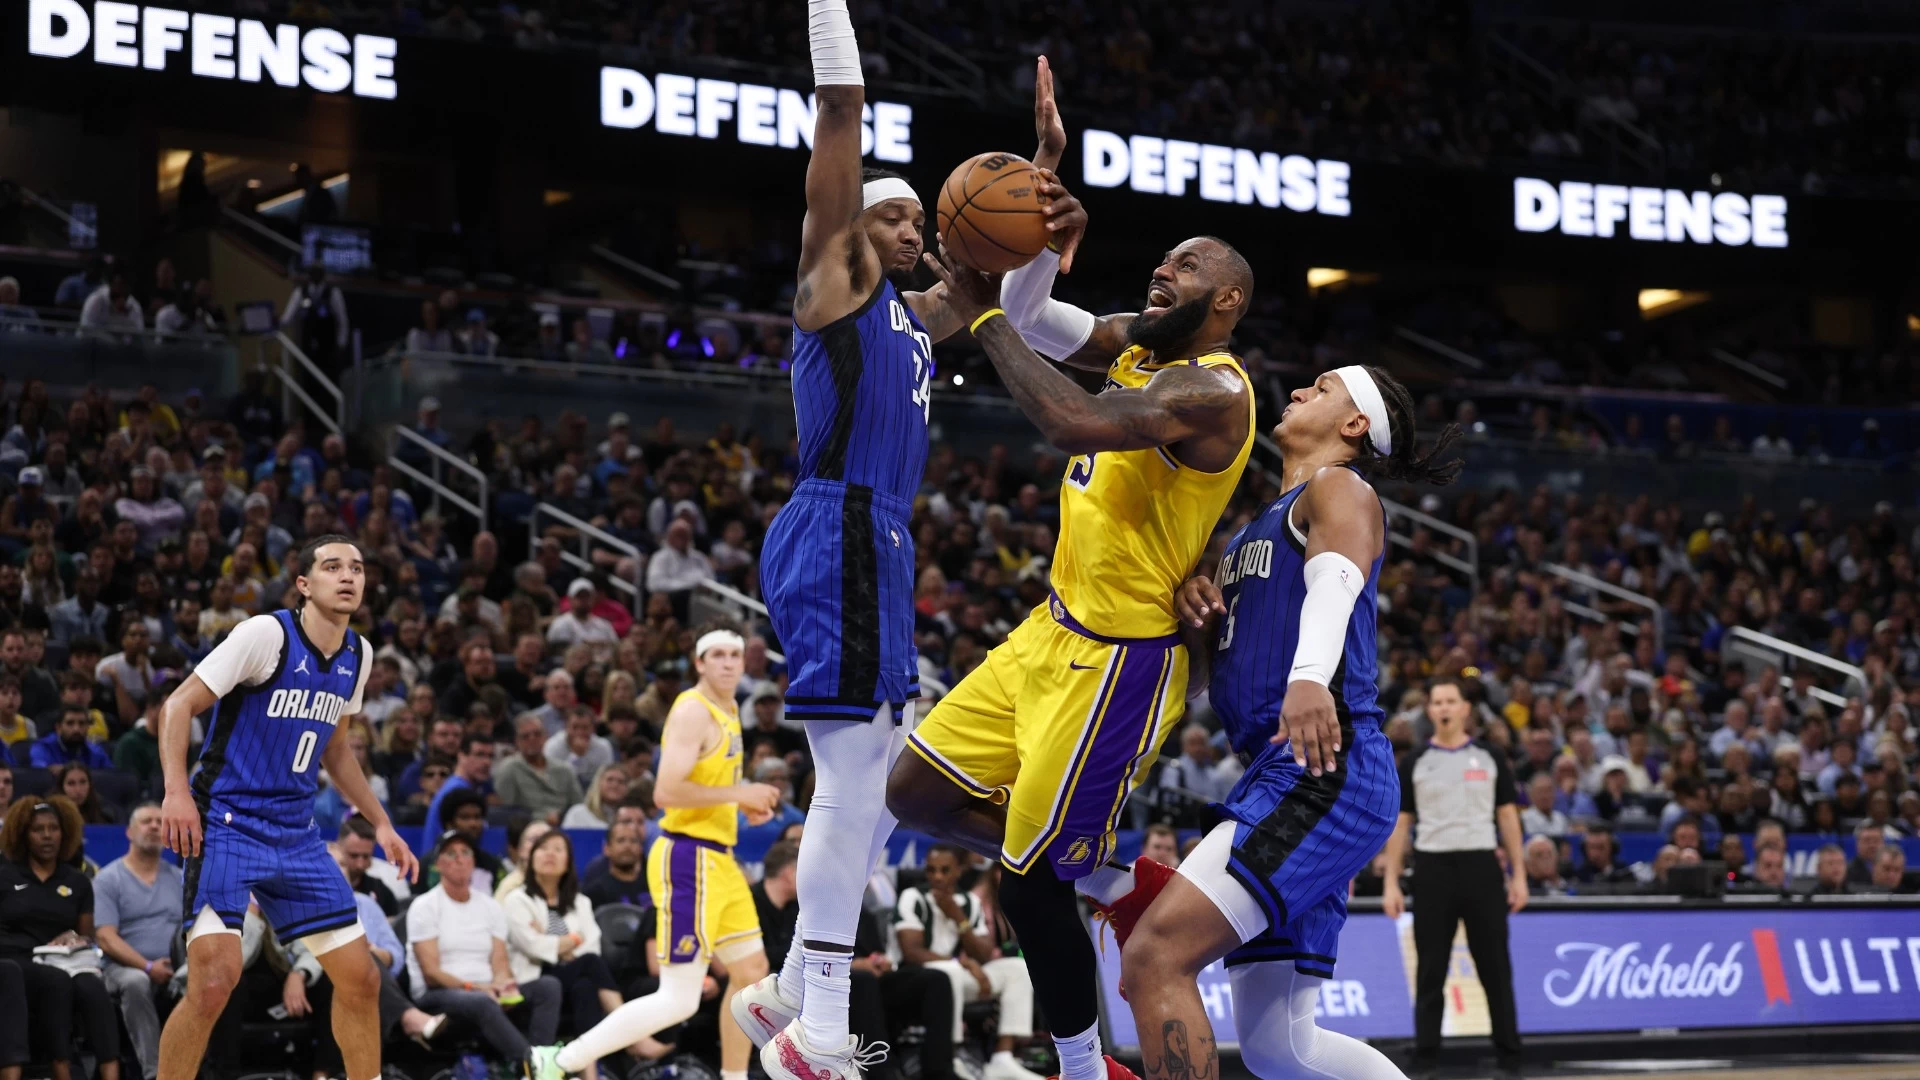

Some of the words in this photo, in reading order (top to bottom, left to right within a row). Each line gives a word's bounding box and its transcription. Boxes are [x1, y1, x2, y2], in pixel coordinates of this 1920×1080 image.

[28, 0, 398, 100] DEFENSE
[600, 66, 913, 163] DEFENE
[1083, 130, 1350, 217] DEFENSE
[1513, 178, 1790, 249] DEFENSE
[266, 688, 346, 726] ORLAND
[291, 730, 318, 774] 0
[1543, 941, 1744, 1007] Michelob
